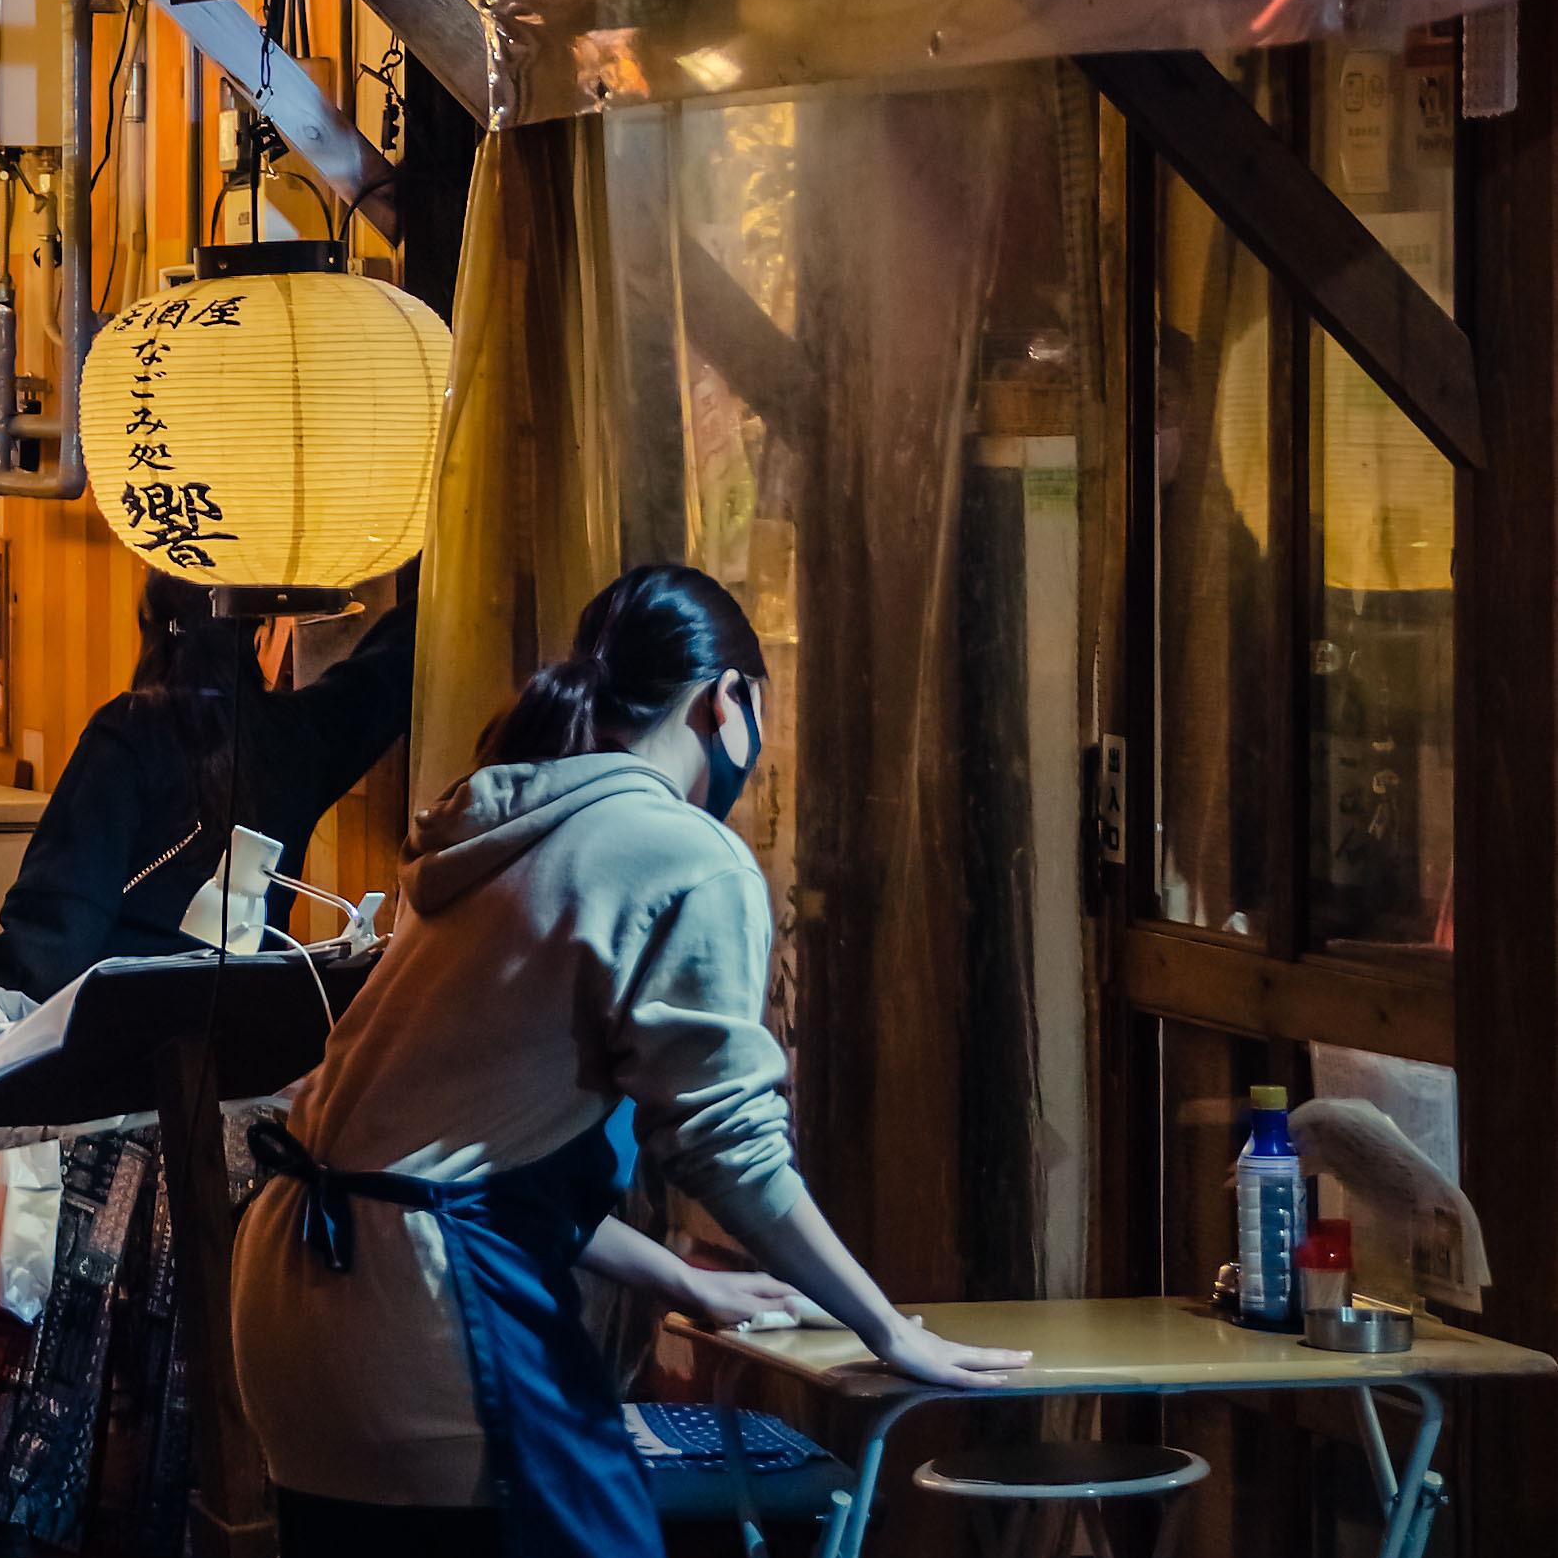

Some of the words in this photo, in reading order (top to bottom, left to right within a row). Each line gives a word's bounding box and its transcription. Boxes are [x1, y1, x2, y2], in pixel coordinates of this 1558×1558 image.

[126, 338, 176, 470] なごみ処
[1108, 746, 1120, 851] 出入口
